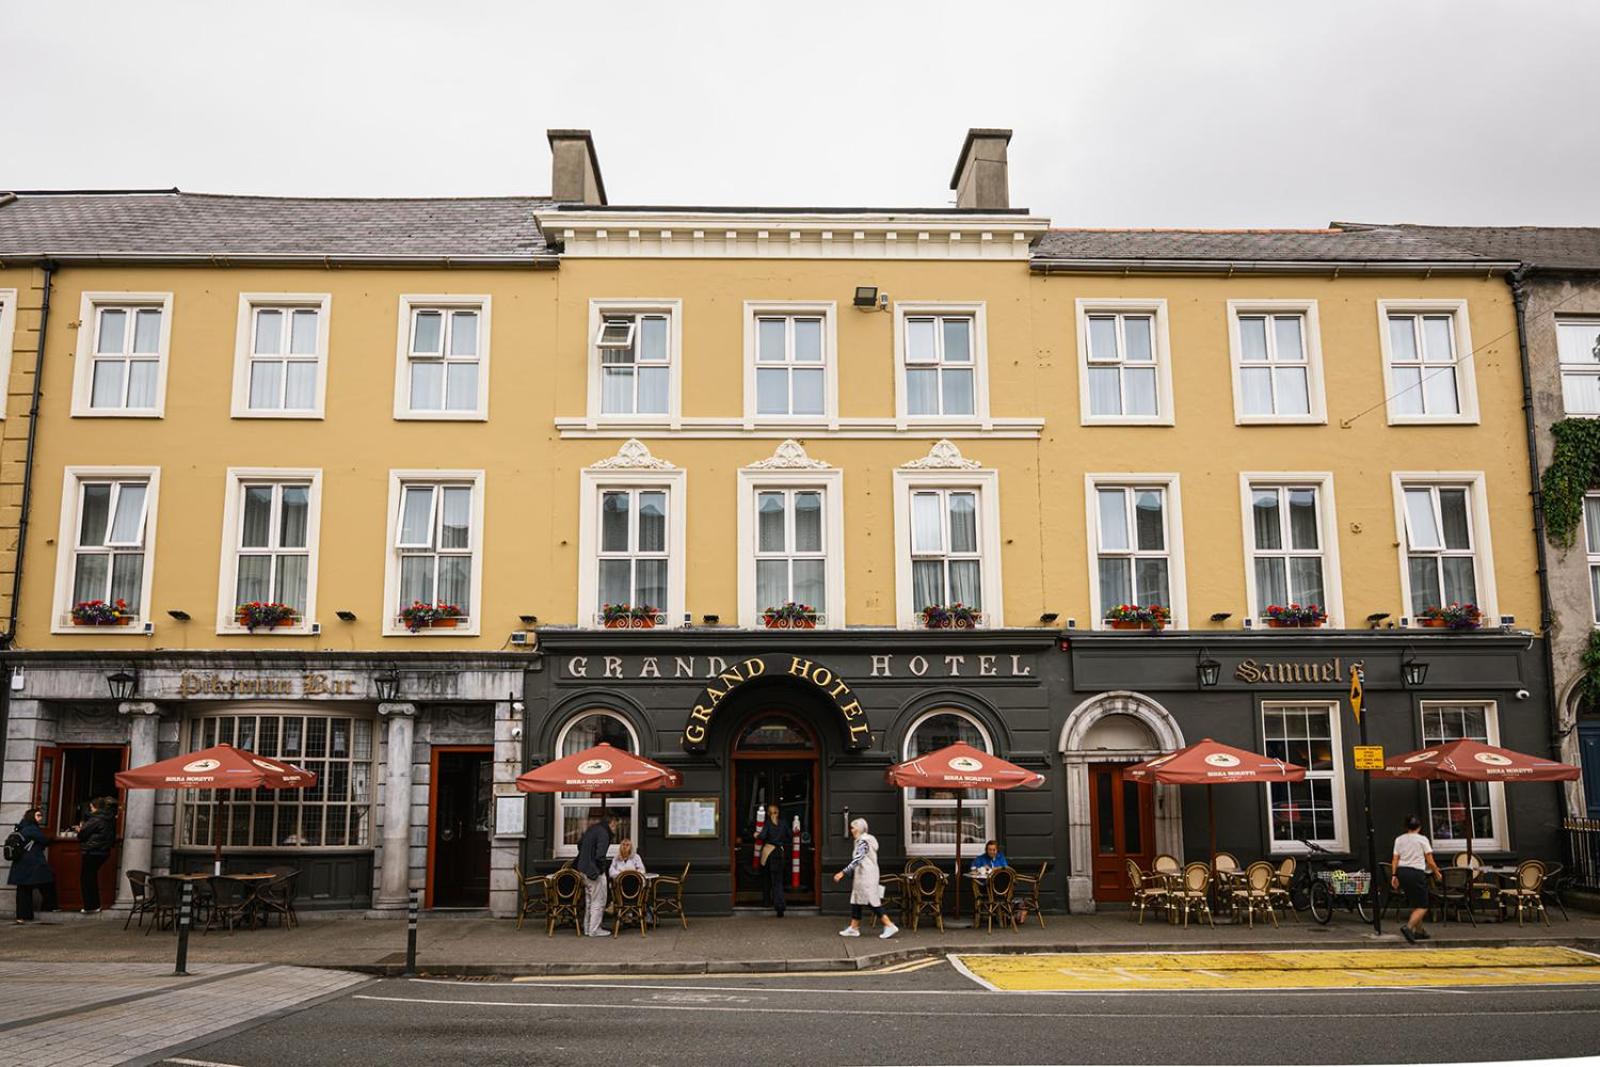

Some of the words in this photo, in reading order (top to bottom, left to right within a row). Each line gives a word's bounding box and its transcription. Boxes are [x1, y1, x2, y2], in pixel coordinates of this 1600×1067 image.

[569, 656, 727, 677] GRAND
[870, 654, 1031, 677] HOTEL
[1236, 658, 1342, 682] Samuel
[302, 672, 356, 695] Bar
[686, 657, 765, 743] GRAND
[788, 656, 869, 743] HOTEL
